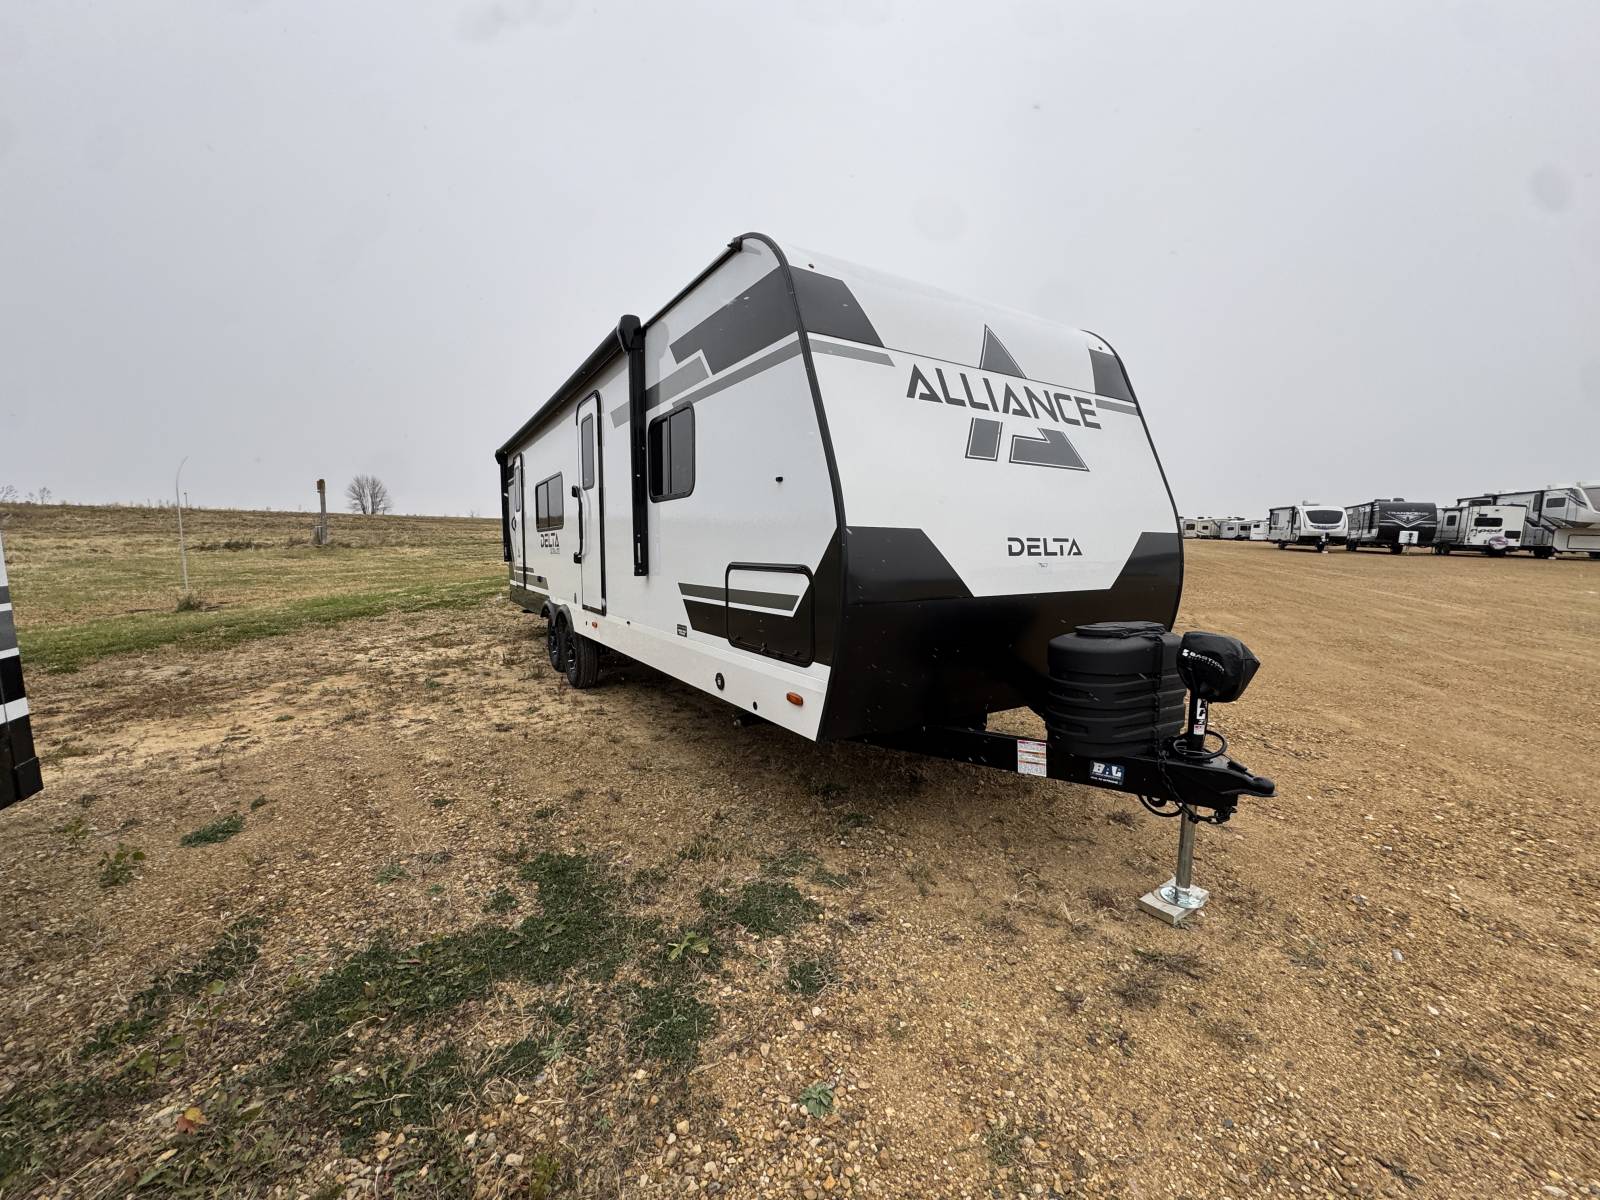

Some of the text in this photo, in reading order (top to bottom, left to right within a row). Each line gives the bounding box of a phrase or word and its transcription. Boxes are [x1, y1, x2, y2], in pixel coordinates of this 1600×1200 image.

[906, 363, 1102, 430] ALLIANCE
[540, 532, 560, 548] DELTA
[1007, 537, 1083, 556] DELTA
